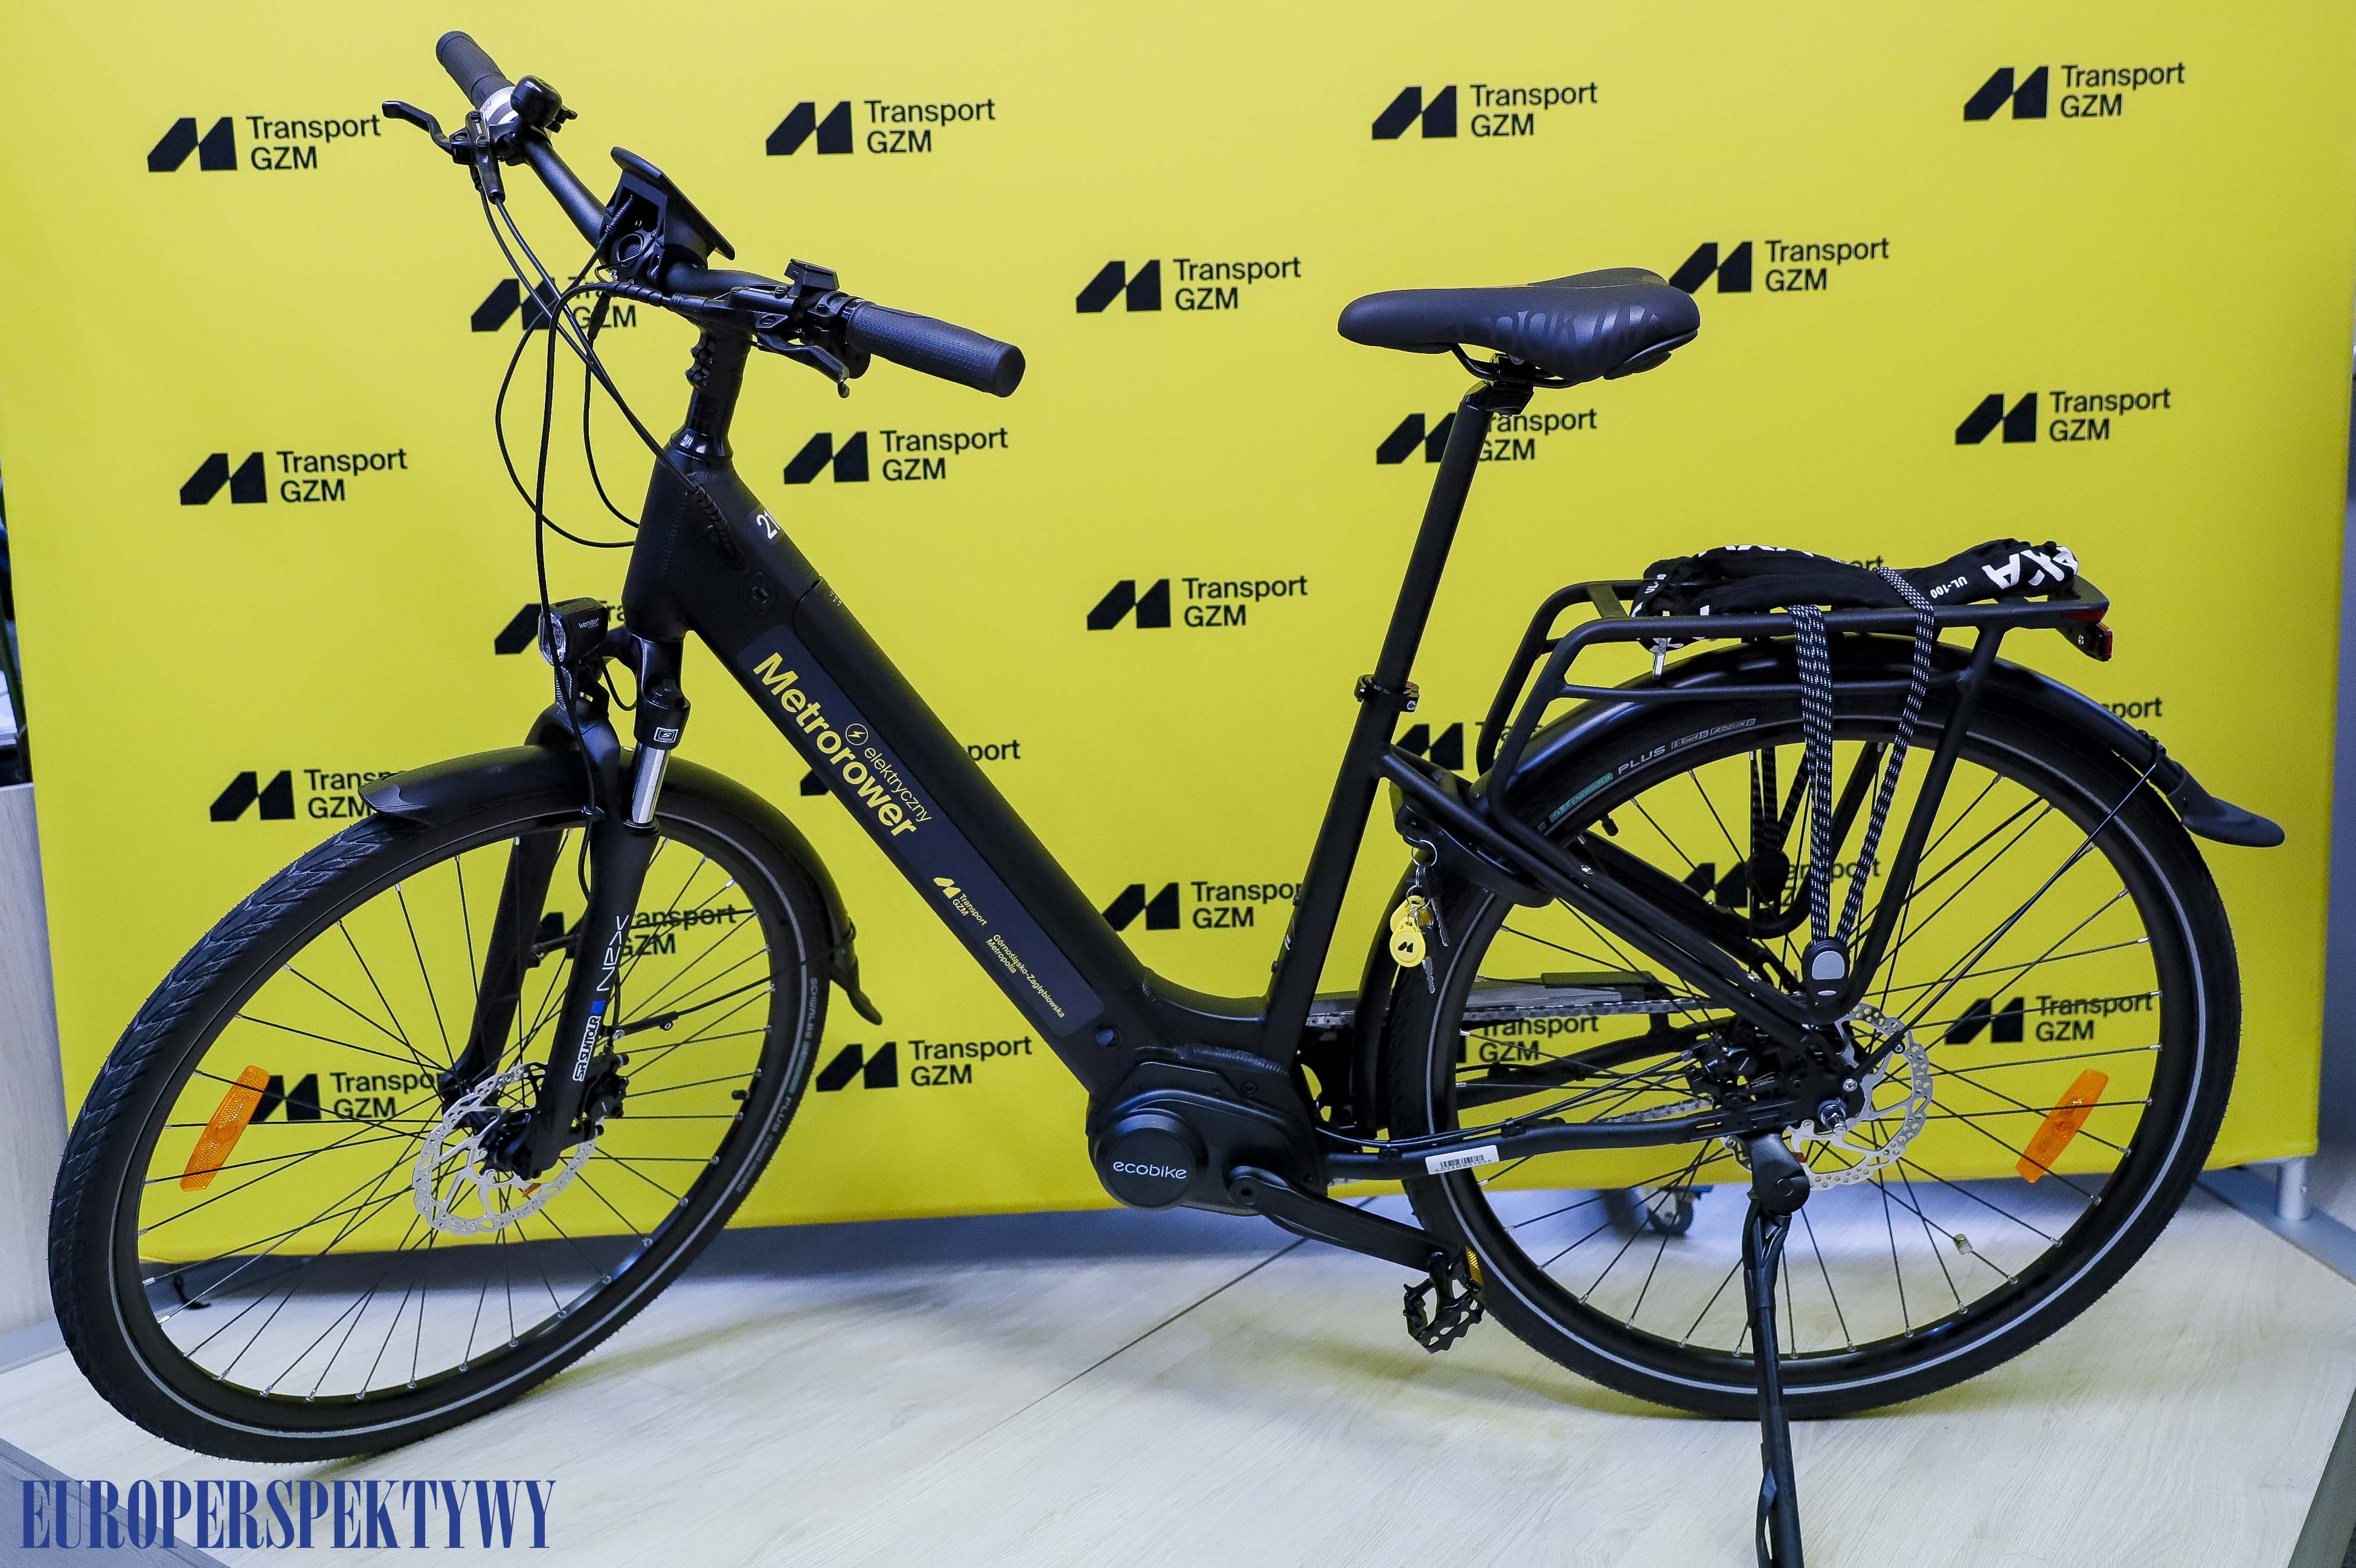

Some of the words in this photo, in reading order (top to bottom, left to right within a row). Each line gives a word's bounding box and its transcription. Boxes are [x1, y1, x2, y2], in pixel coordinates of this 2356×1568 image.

[2062, 63, 2185, 89] Transport
[1470, 82, 1597, 109] Transport
[2060, 94, 2122, 118] GZM
[864, 98, 995, 126] Transport
[246, 115, 381, 143] Transport
[1471, 114, 1533, 137] GZM
[867, 130, 931, 153] GZM
[251, 146, 318, 170] GZM
[1765, 237, 1889, 265] Transport
[1173, 257, 1301, 281] Transport
[1765, 268, 1827, 292] GZM
[1175, 287, 1238, 311] GZM
[573, 304, 637, 328] GM
[2049, 388, 2171, 413] Transport
[1487, 409, 1596, 435] ransport
[2049, 418, 2110, 442] GZM
[881, 428, 1008, 455] Transport
[276, 448, 408, 475] Transport
[882, 457, 946, 481] GZM
[280, 478, 345, 503] GZM
[756, 510, 781, 539] 21
[1181, 576, 1308, 602] Transport
[1930, 576, 1968, 599] UL-100
[1184, 604, 1246, 628] GZM
[753, 652, 916, 837] Metrorower
[1618, 745, 1666, 774] PLUS
[865, 748, 932, 822] elektryczny
[308, 795, 371, 819] GZM
[952, 899, 969, 917] GZM
[958, 893, 989, 927] Transport
[1192, 907, 1254, 929] GZM
[986, 938, 1017, 974] Metropolia
[993, 934, 1066, 1018] Górnośląsko-Zagłębiowska
[2036, 994, 2152, 1018] Transport
[2035, 1020, 2094, 1042] GZM
[908, 1036, 1033, 1061] Transport
[1480, 1039, 1539, 1062] GZM
[910, 1064, 973, 1087] GZM
[333, 1096, 397, 1119] GZM
[1112, 1161, 1187, 1179] ecobike
